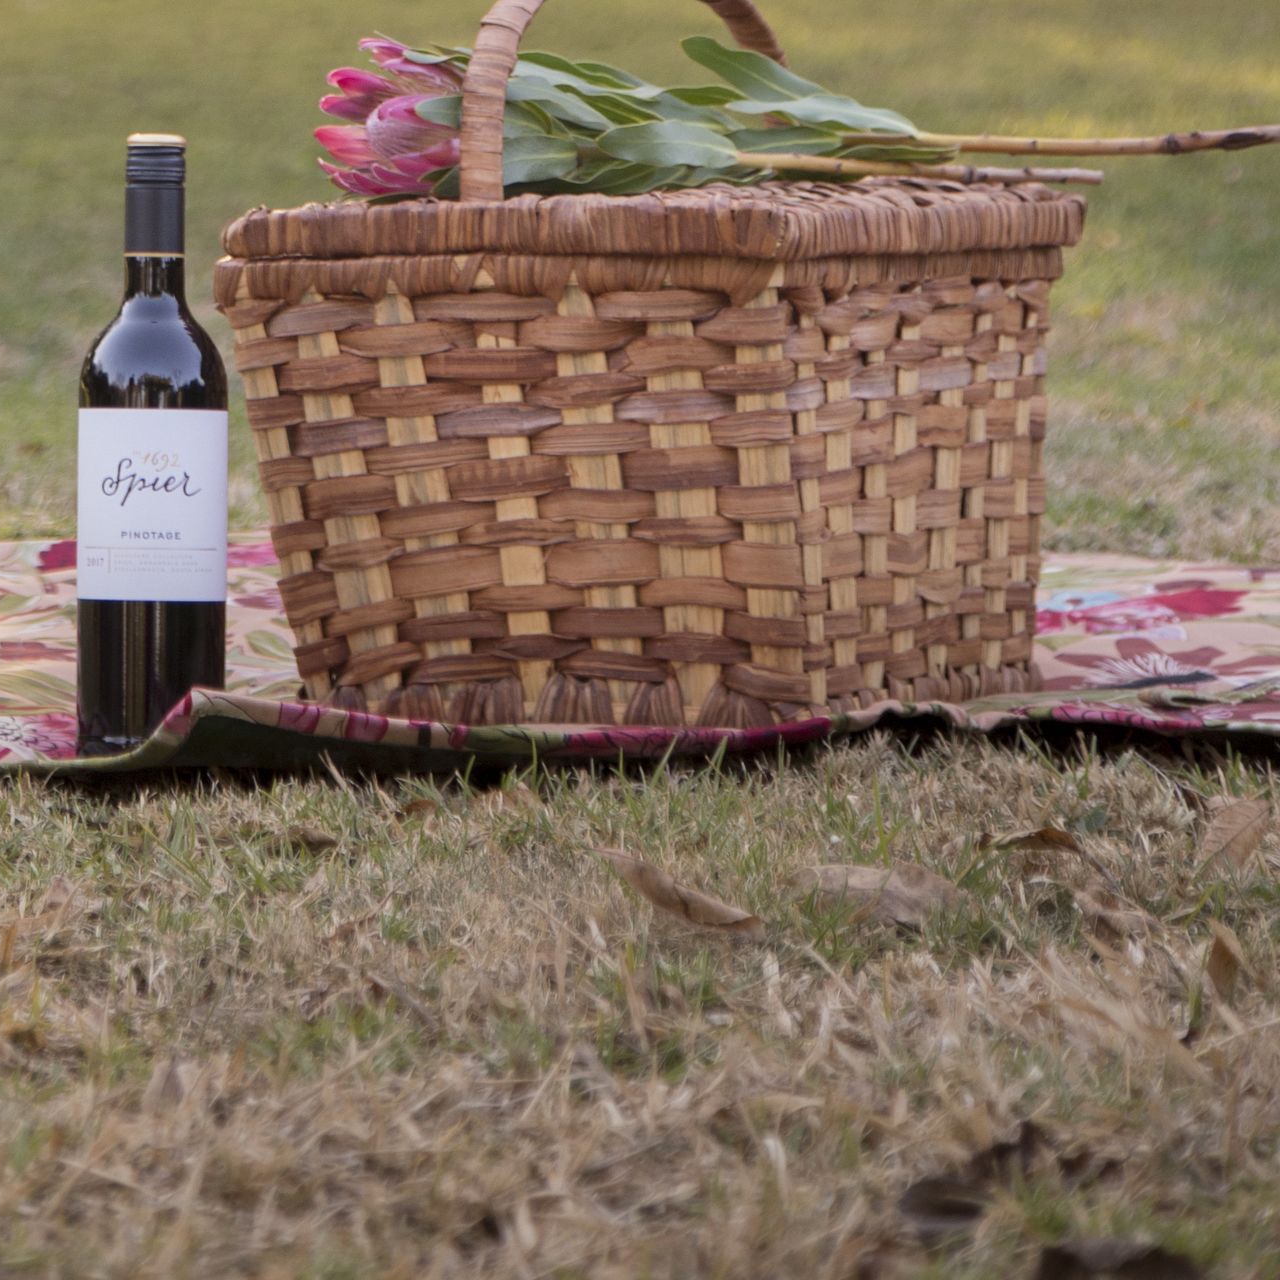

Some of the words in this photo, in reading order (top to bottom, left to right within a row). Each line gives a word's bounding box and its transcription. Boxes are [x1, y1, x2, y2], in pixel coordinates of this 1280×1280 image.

[142, 450, 181, 472] 1692
[102, 458, 202, 506] Spier
[121, 531, 181, 540] PINOTAGE
